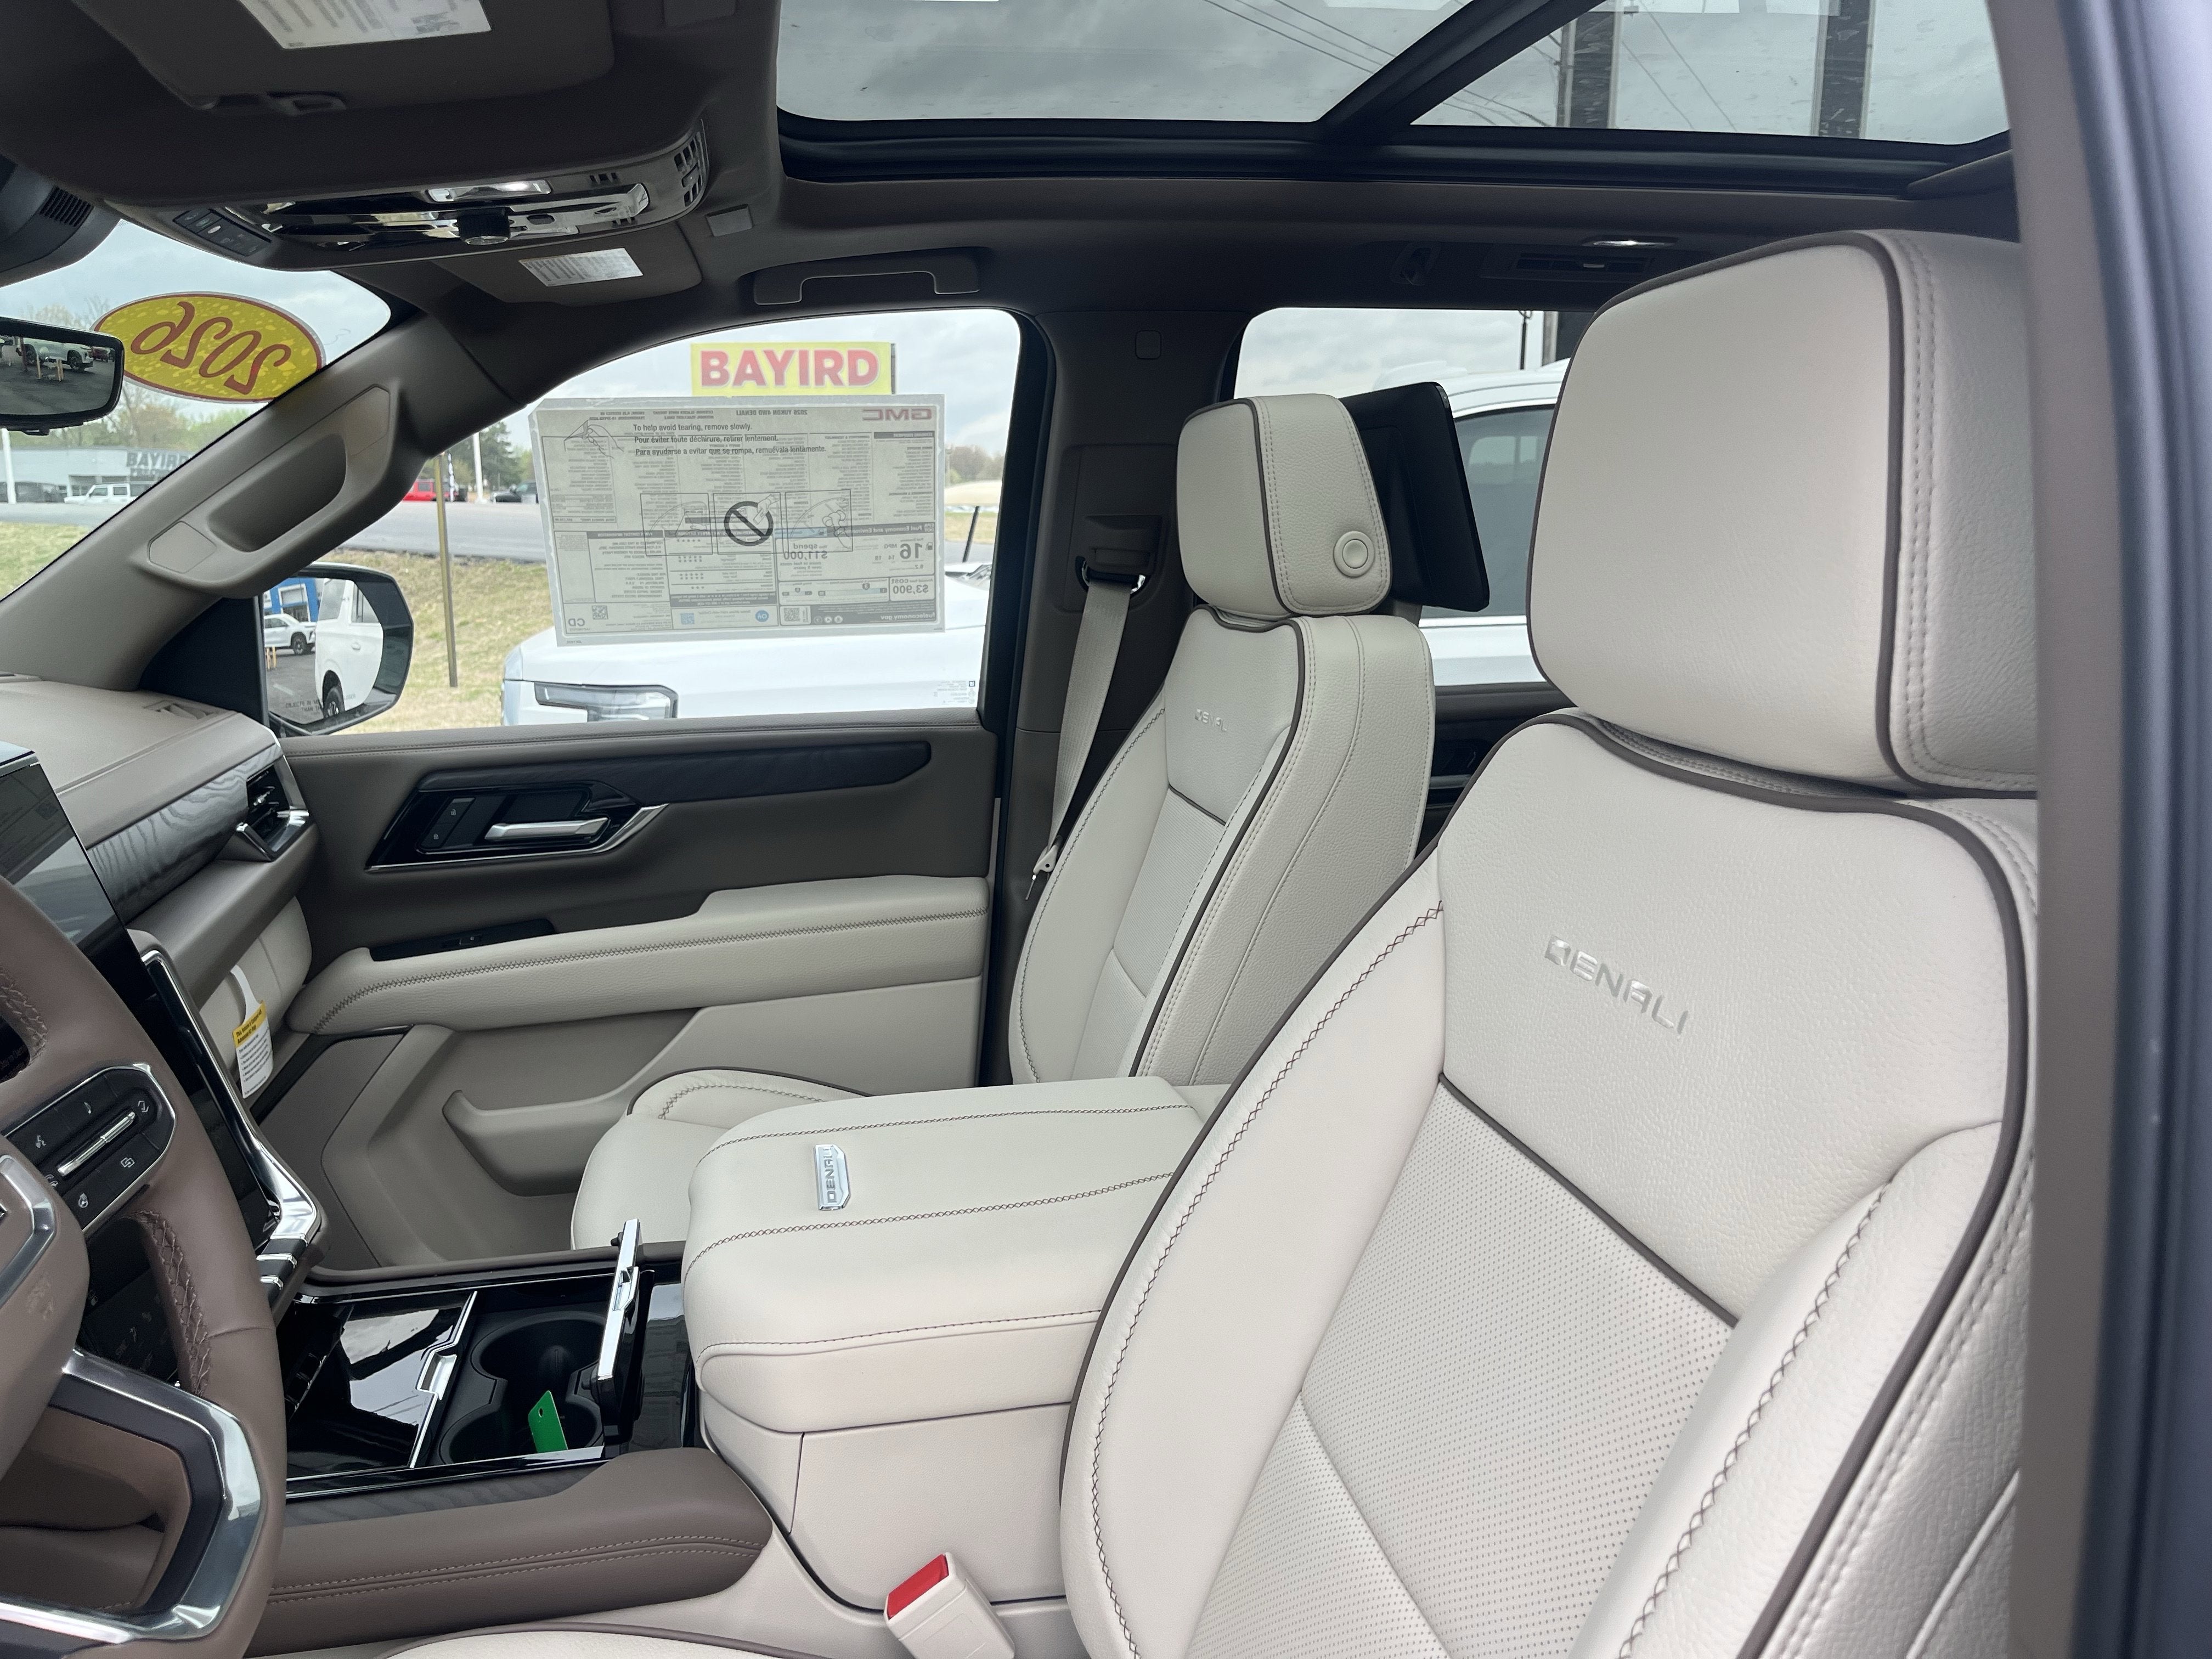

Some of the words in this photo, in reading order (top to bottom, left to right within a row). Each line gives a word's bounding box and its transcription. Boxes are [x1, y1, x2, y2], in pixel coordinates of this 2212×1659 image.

[700, 348, 880, 387] BAYIRD
[678, 424, 703, 432] tearing,
[730, 423, 752, 431] slowly.
[1544, 934, 1689, 1035] DENALI
[822, 1145, 838, 1203] DENALI
